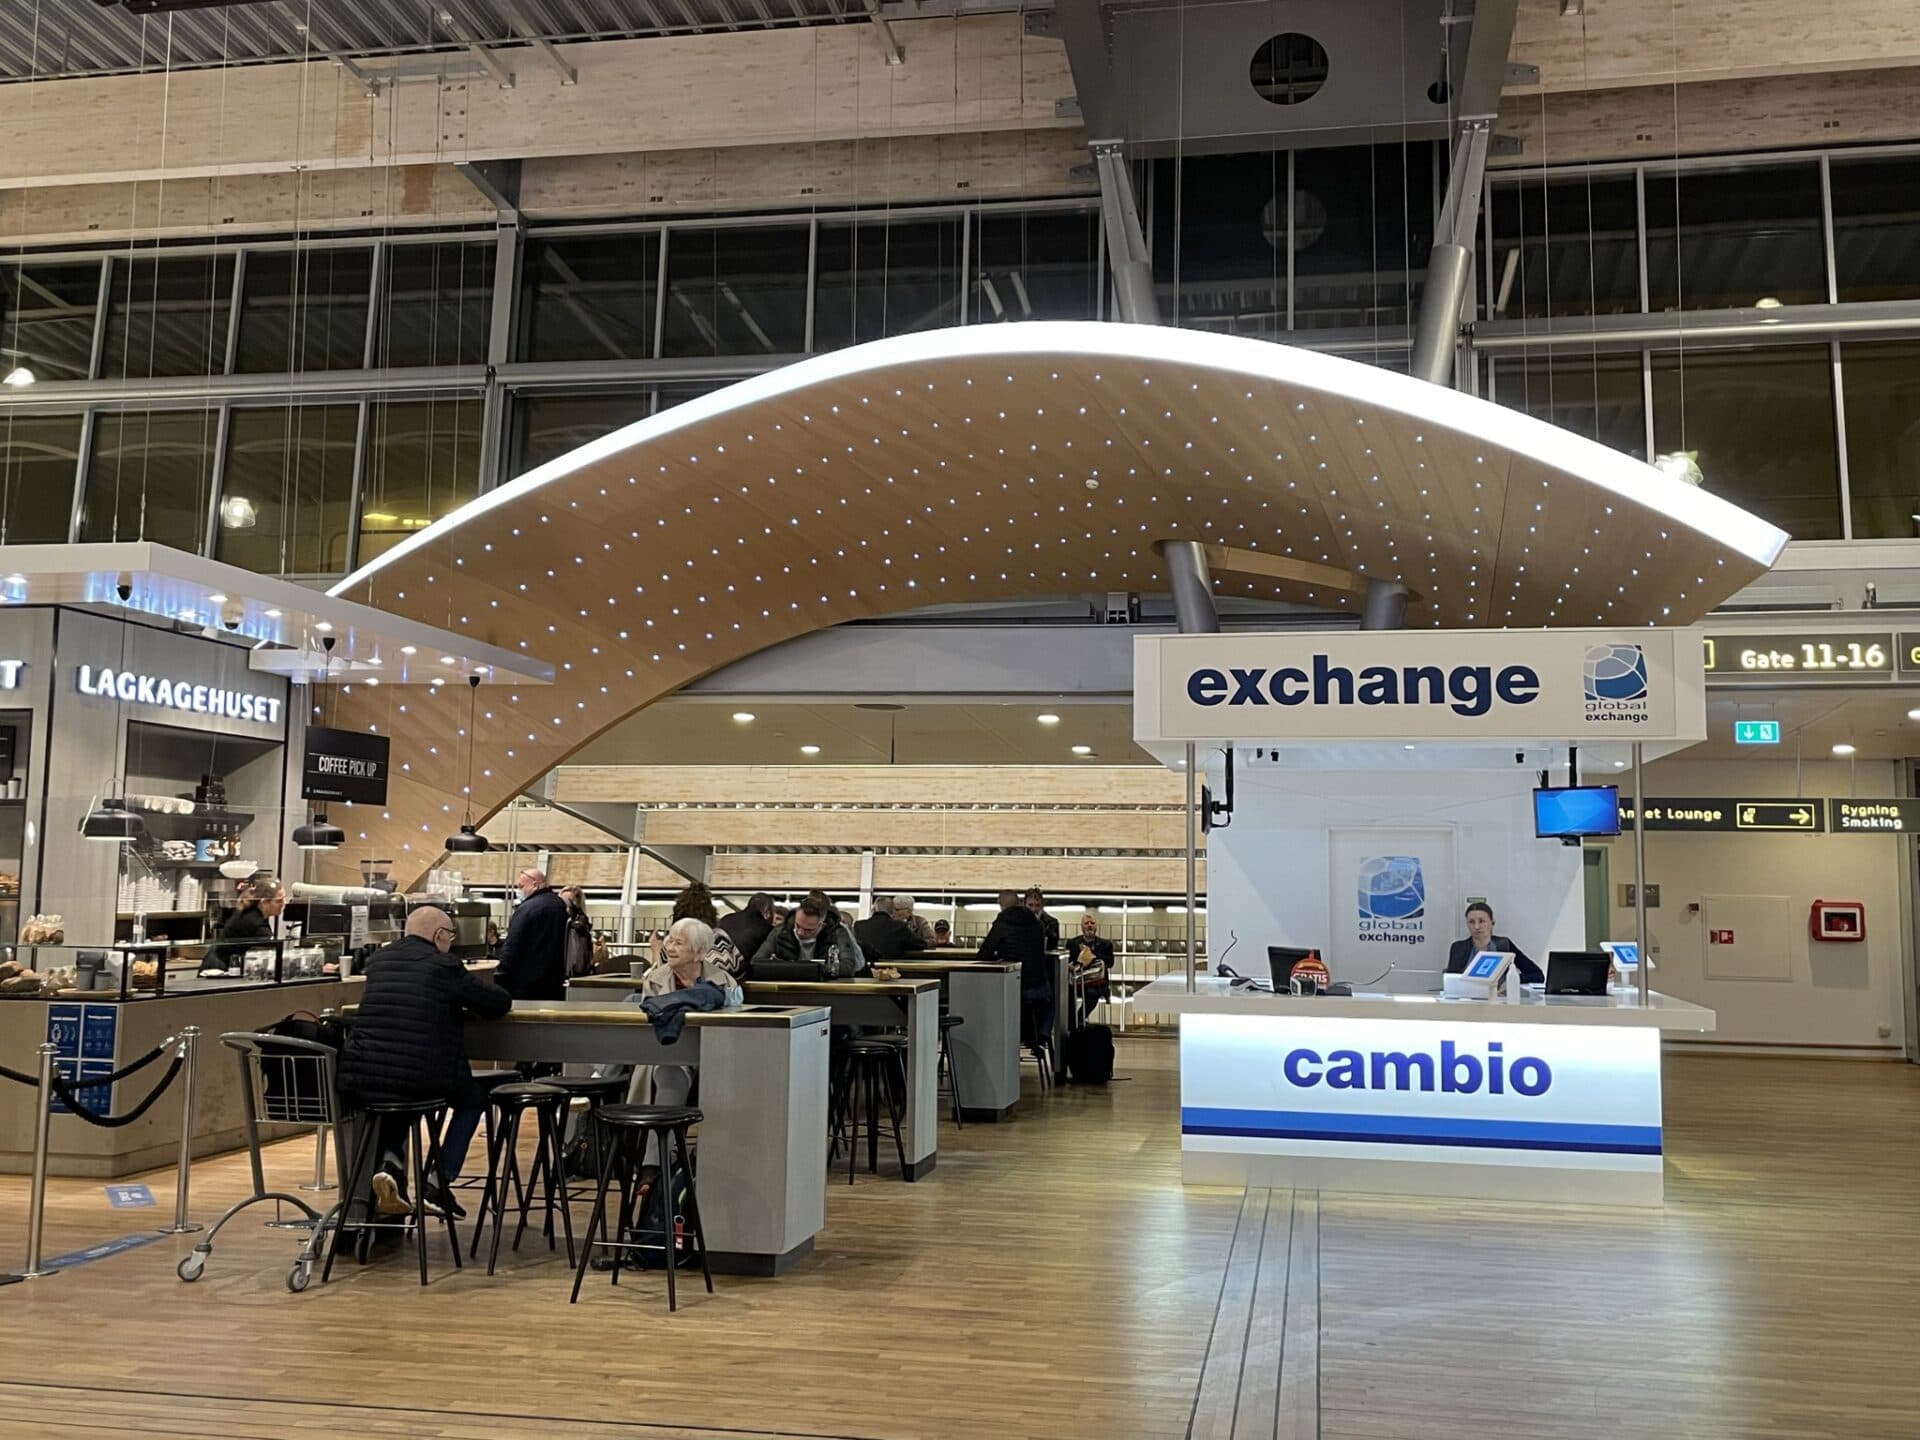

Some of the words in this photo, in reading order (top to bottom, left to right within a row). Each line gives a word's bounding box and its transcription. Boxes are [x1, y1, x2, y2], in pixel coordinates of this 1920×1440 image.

[1740, 649, 1795, 669] Gate
[1801, 643, 1886, 668] 11-16
[1187, 655, 1541, 717] exchange
[79, 664, 281, 723] LAGKAGEHUSET
[1585, 701, 1647, 712] global
[1585, 712, 1648, 723] exchange
[318, 756, 348, 775] COFFEE
[349, 760, 366, 776] PICK
[366, 762, 377, 777] UP
[1667, 807, 1722, 822] Lounge
[1841, 804, 1899, 817] Rygning
[1841, 816, 1903, 830] Smoking
[1359, 920, 1423, 932] global
[1359, 932, 1425, 945] exchange
[1283, 1039, 1553, 1097] cambio
